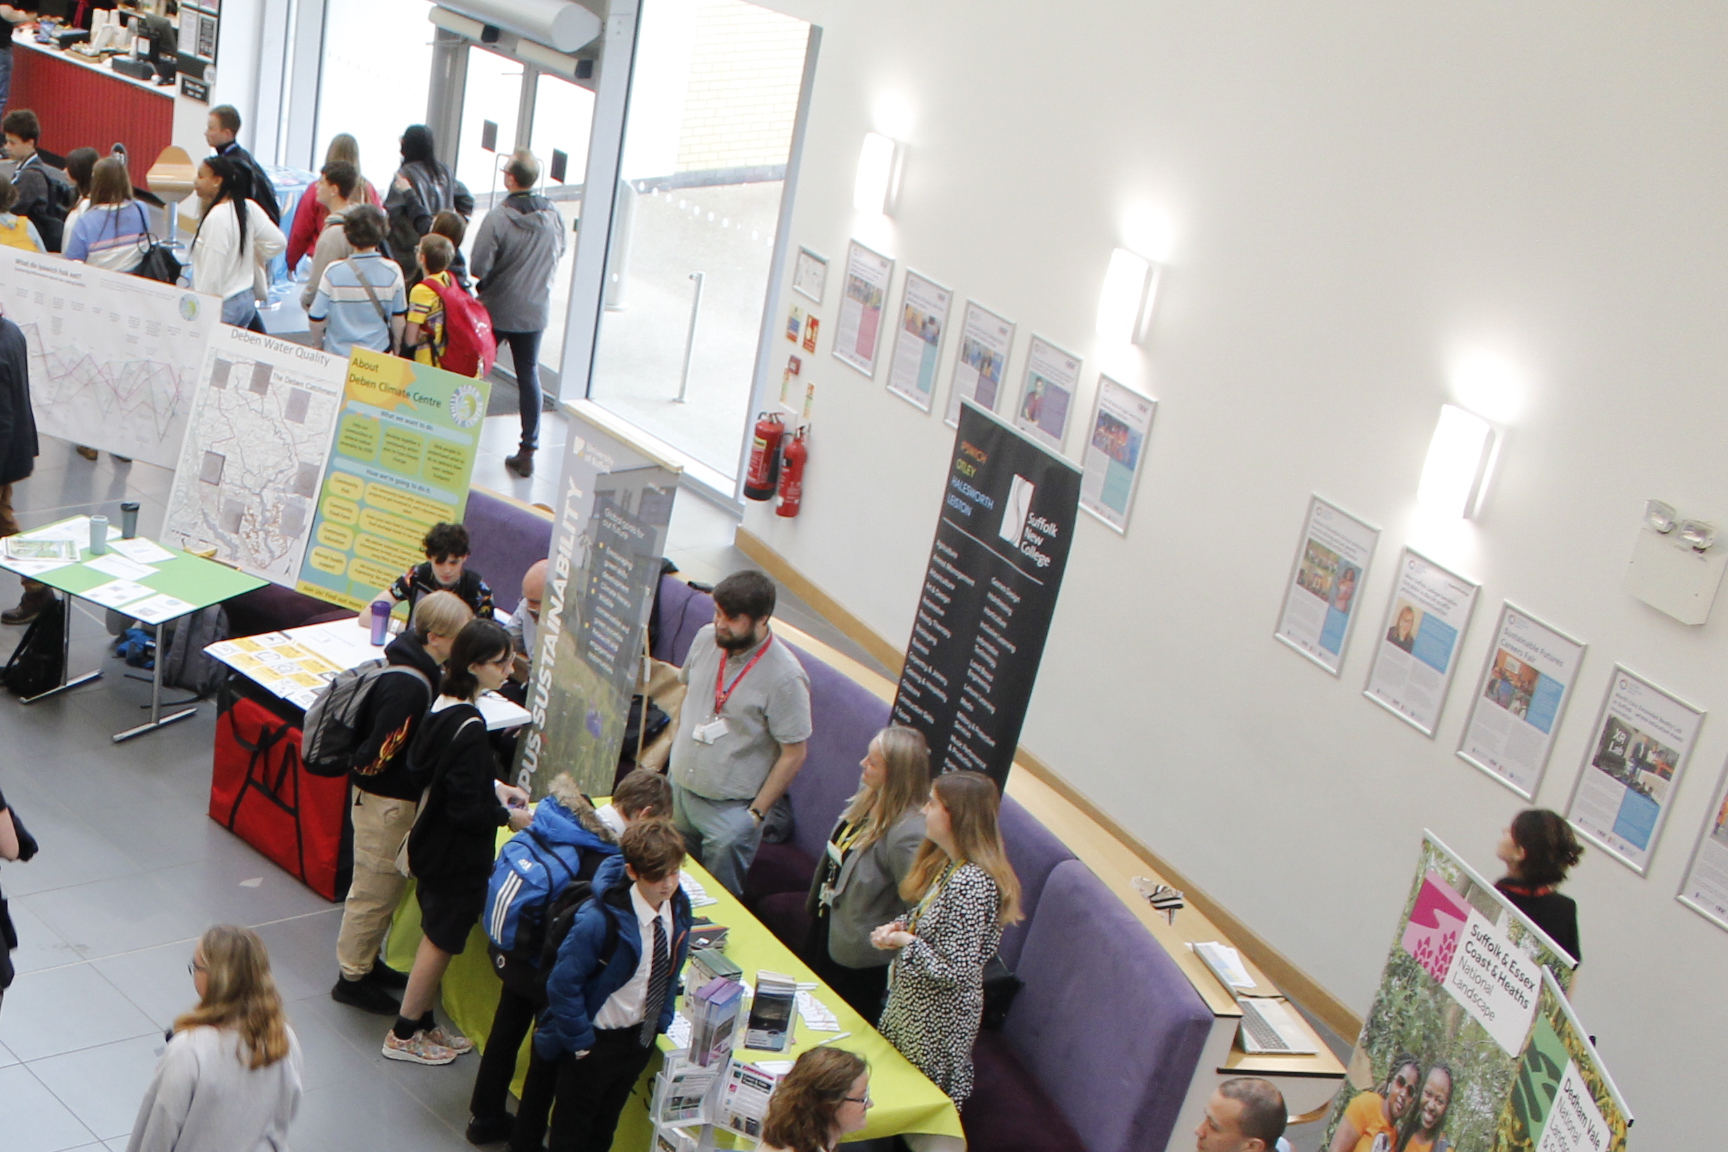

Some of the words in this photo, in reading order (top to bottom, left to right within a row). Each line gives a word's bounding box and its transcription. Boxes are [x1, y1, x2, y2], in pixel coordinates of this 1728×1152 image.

[231, 328, 261, 346] Deben
[264, 338, 292, 355] Water
[295, 346, 330, 368] Quality
[352, 357, 379, 373] About
[284, 376, 304, 388] Deben
[305, 381, 338, 398] Catchment
[349, 373, 377, 390] Deben
[378, 380, 412, 399] Climate
[413, 392, 442, 409] Centre
[955, 458, 978, 478] OTLEY
[946, 493, 973, 517] LEISTON
[951, 475, 994, 511] HALESWORTH
[1024, 527, 1044, 546] New
[1028, 512, 1058, 538] Suffolk
[1020, 541, 1051, 568] College
[532, 475, 584, 731] SUSTAINABILITY
[1501, 638, 1524, 657] Careers
[1524, 651, 1536, 663] Fair
[1504, 627, 1540, 653] Sustainable
[1540, 648, 1564, 668] Futures
[1608, 741, 1624, 757] Lab
[1612, 728, 1627, 745] XR
[1470, 924, 1502, 960] Suffolk
[1501, 953, 1509, 967] &
[1508, 960, 1536, 992] Essex
[1458, 956, 1495, 997] National
[1465, 941, 1491, 972] Coast
[1491, 965, 1499, 978] &
[1498, 971, 1529, 1010] Heaths
[1452, 971, 1496, 1022] Landscape
[1556, 1095, 1582, 1147] National
[1563, 1077, 1588, 1129] Dedham
[1587, 1118, 1601, 1152] Vale
[1542, 1134, 1551, 1150] &
